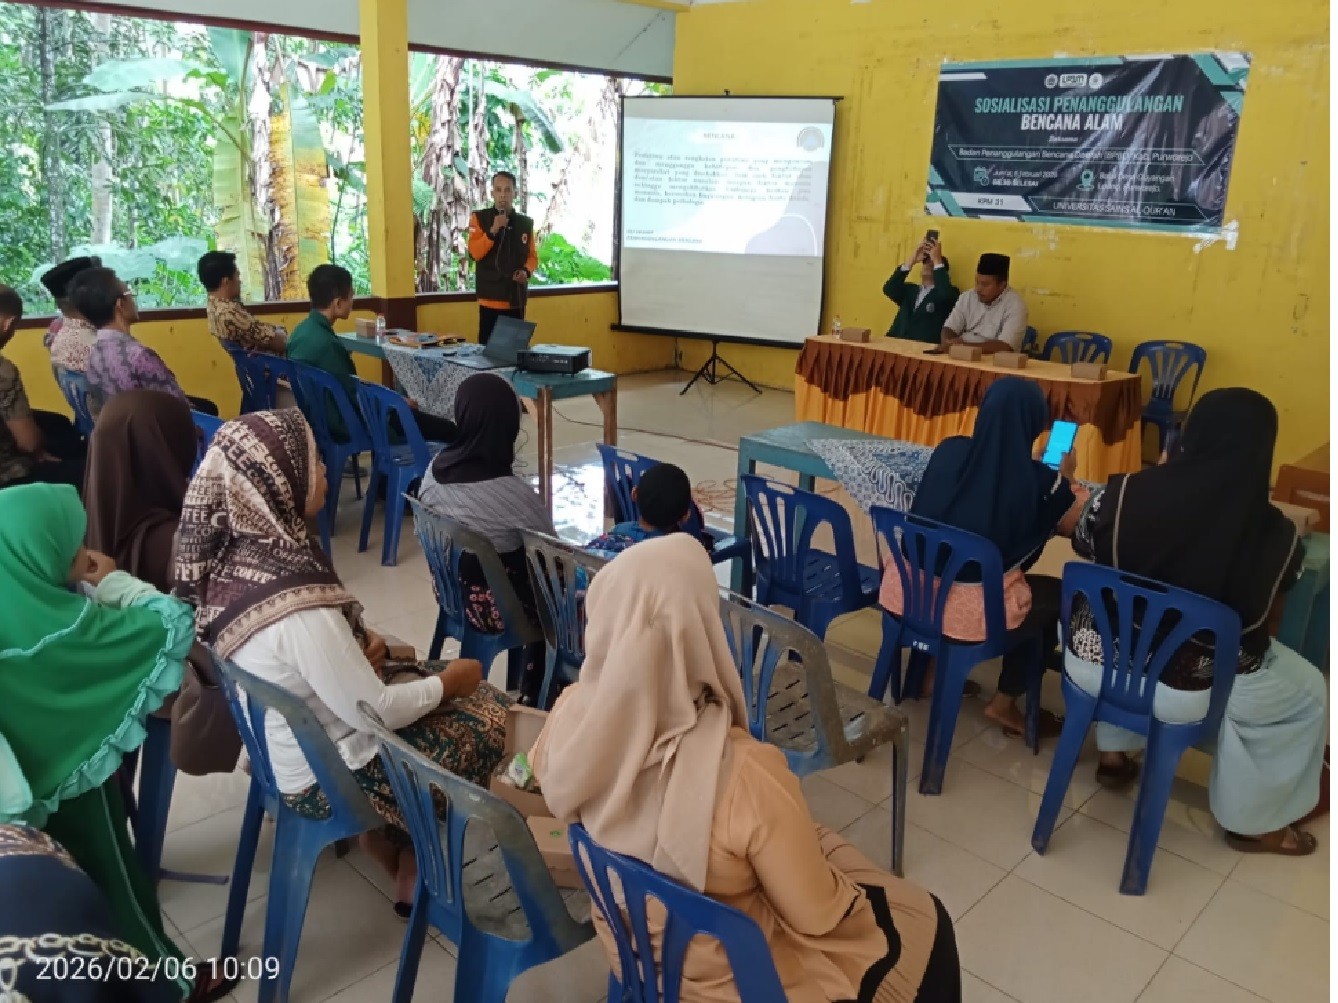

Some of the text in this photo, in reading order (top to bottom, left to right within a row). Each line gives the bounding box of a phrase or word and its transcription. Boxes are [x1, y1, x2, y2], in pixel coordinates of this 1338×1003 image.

[974, 97, 1050, 113] SOSIALISASI
[1020, 113, 1123, 131] BENCANA ALAM
